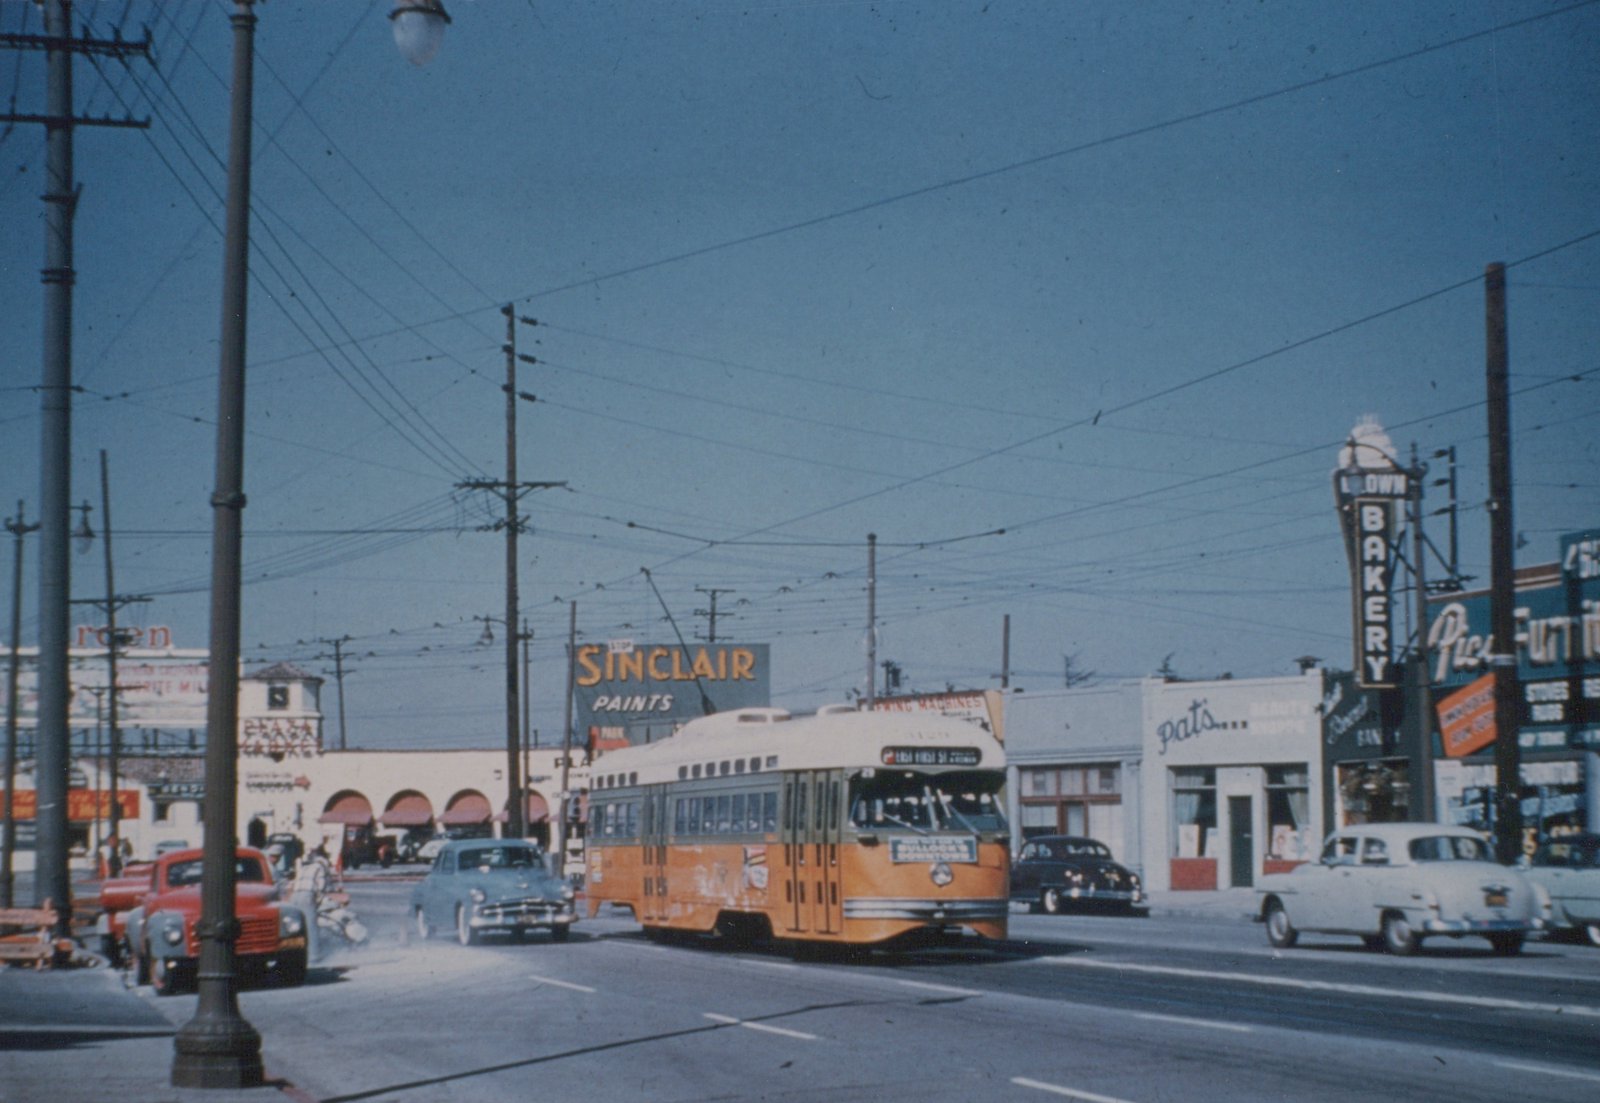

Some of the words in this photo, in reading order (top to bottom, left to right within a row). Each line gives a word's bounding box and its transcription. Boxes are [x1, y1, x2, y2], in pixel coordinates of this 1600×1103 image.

[1361, 505, 1387, 682] BAKERY
[576, 645, 756, 687] SINCLAIR
[592, 694, 673, 712] PAINTS
